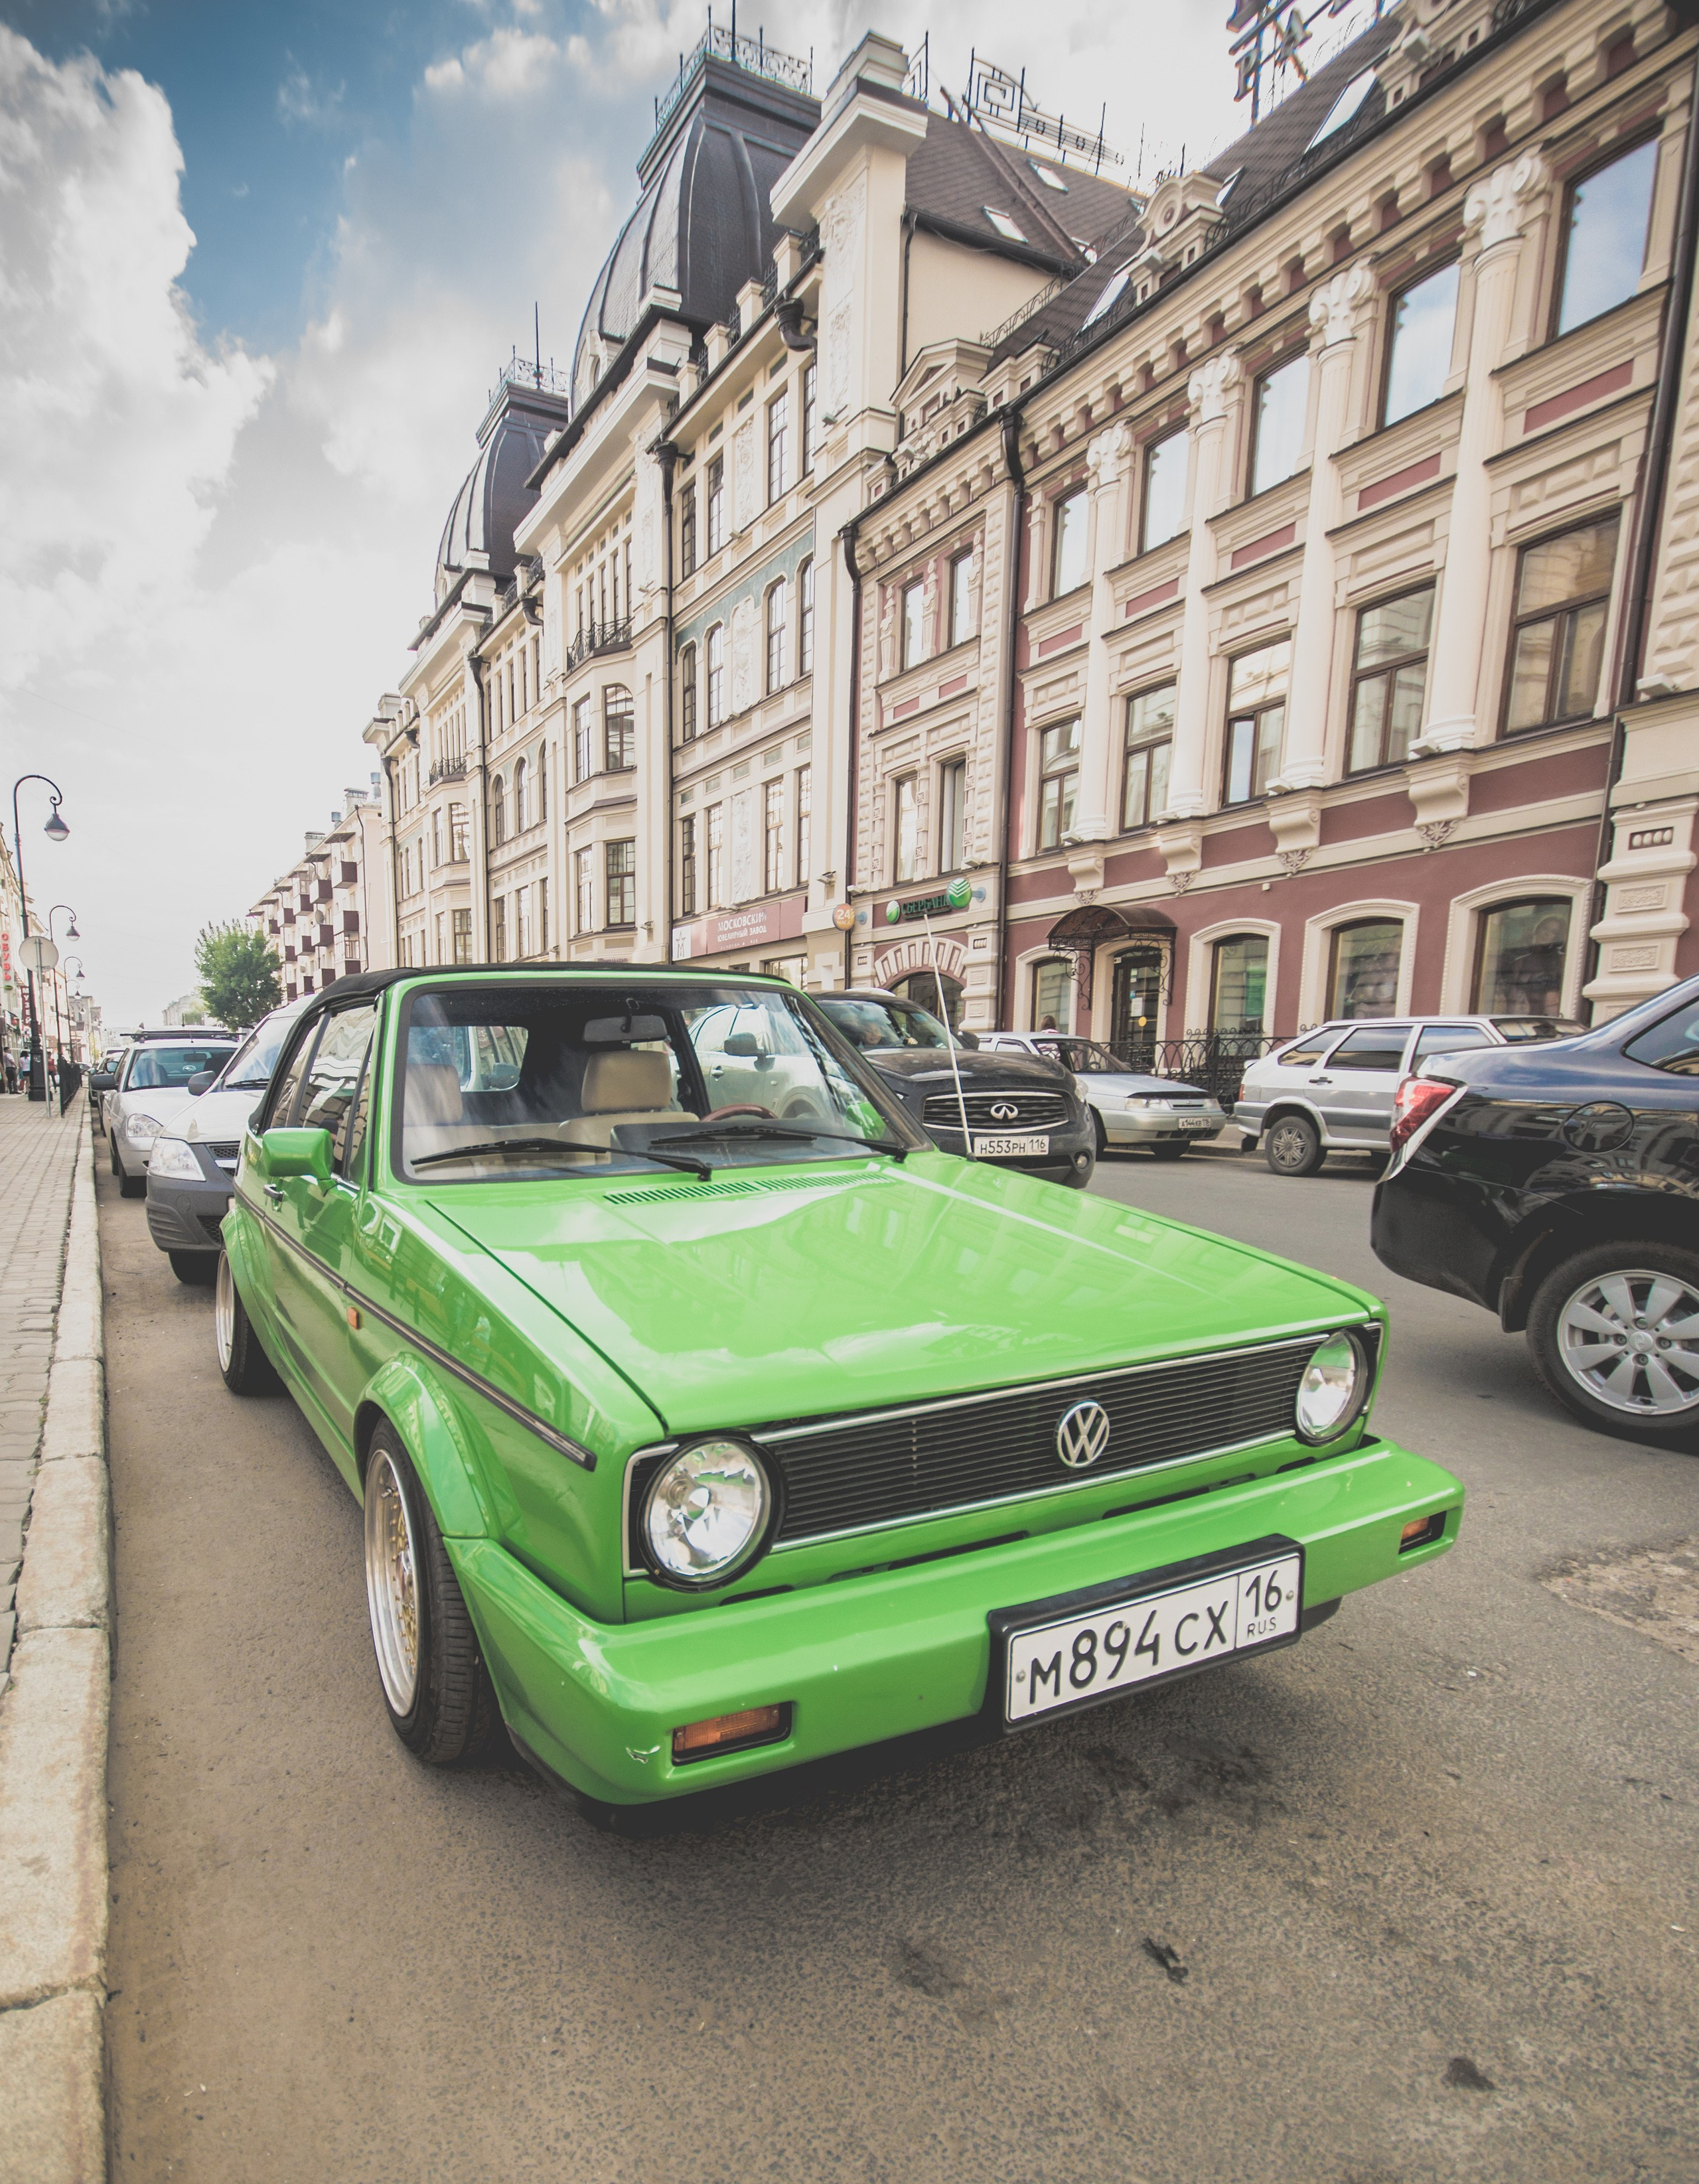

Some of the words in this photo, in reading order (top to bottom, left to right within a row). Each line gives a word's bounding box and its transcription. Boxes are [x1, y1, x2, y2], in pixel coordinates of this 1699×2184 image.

[717, 912, 767, 932] МОСКОВСКИЙ
[836, 909, 851, 920] 24
[717, 928, 748, 942] ЮВЕЛИРНЫЙ
[749, 924, 767, 936] ЗАВОД
[1, 933, 11, 981] ОБУВЬ
[22, 987, 31, 1024] МУЗЕЙ
[980, 1140, 1026, 1154] Н553РН
[1029, 1139, 1045, 1149] 116
[1029, 1600, 1228, 1704] М894СХ
[1246, 1570, 1282, 1618] 16
[1247, 1617, 1277, 1638] RUS
